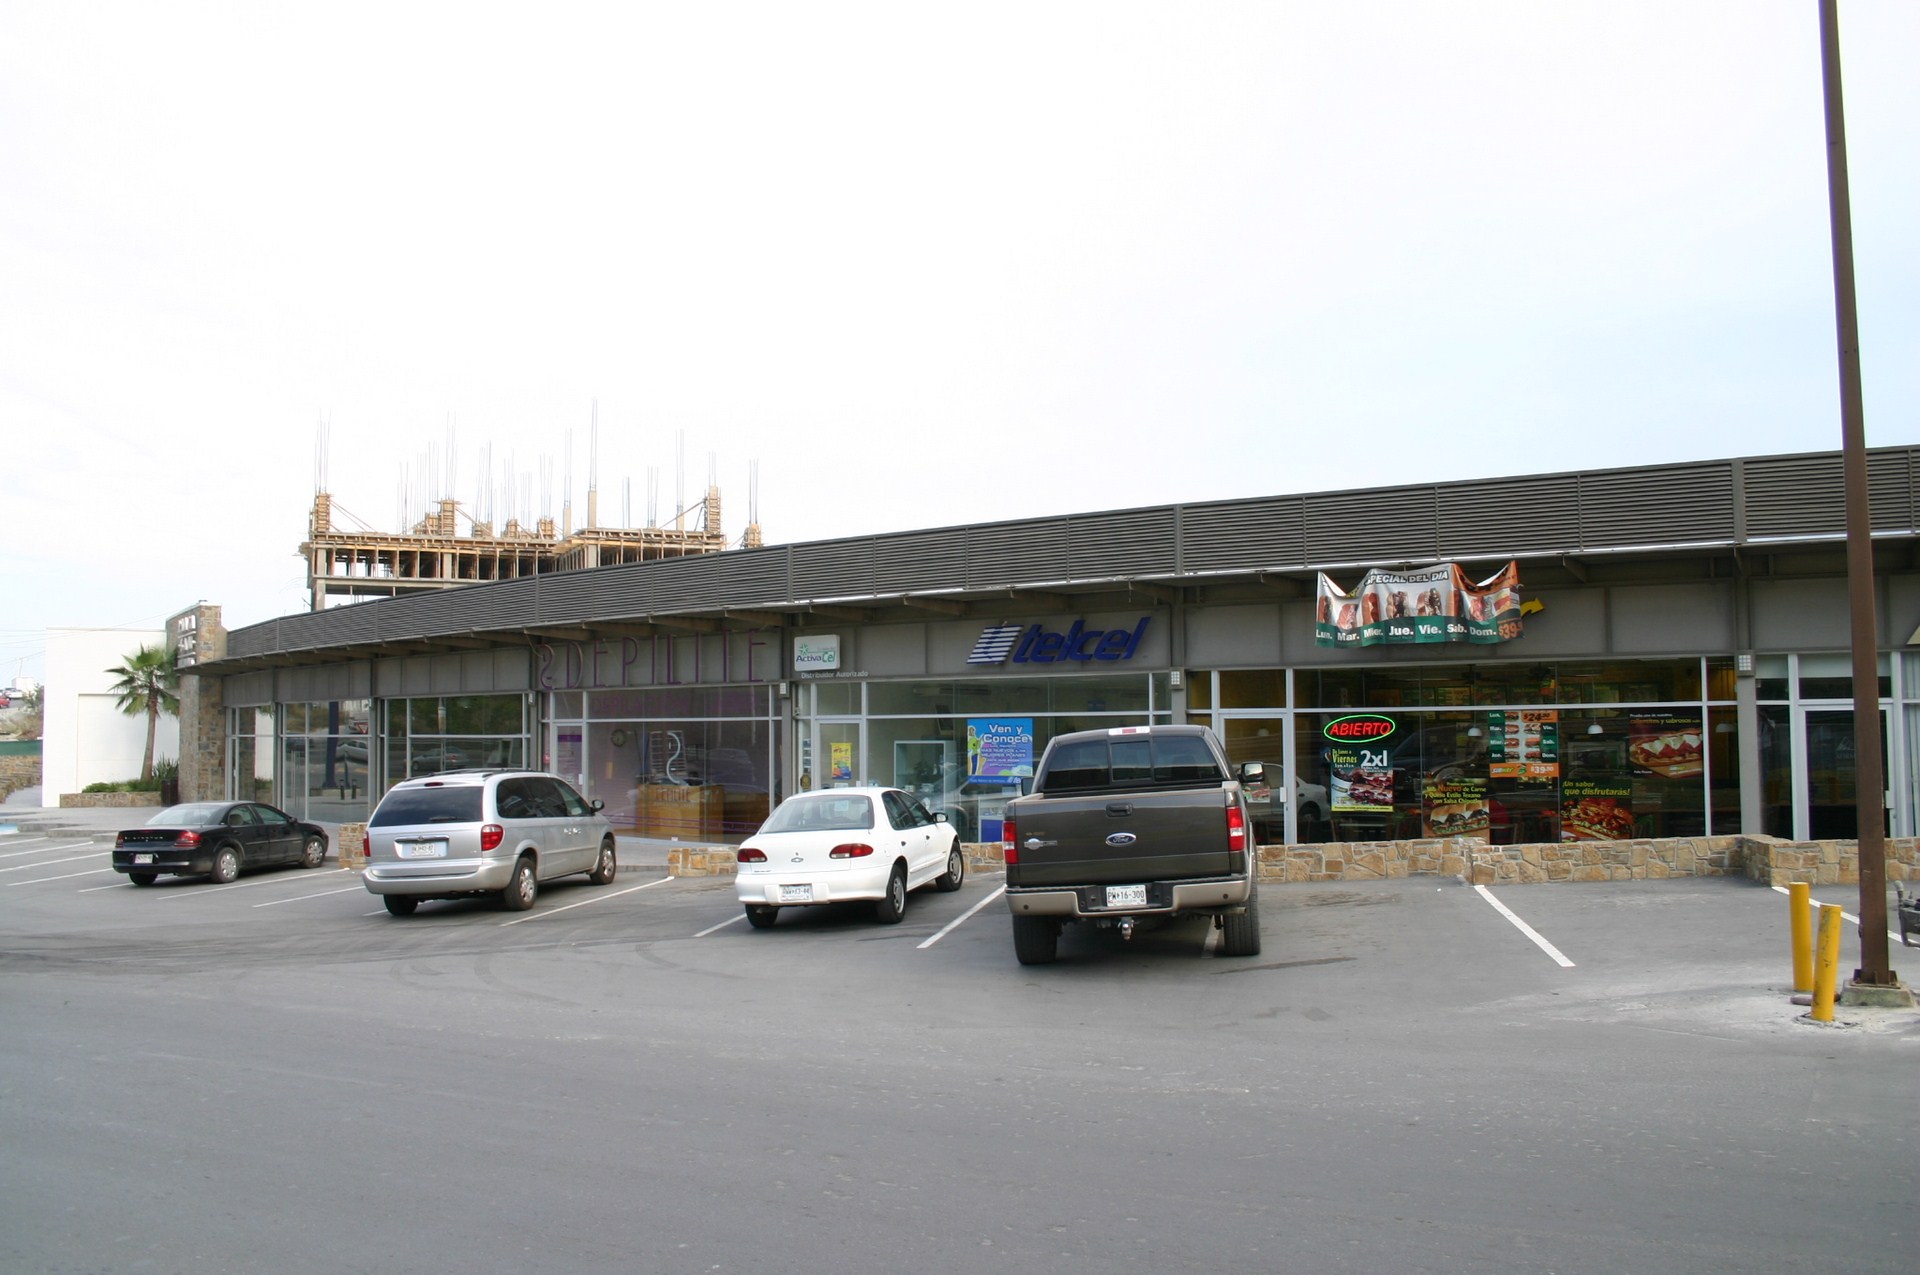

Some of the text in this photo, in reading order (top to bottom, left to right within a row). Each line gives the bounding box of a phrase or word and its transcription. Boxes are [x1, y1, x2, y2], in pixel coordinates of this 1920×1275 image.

[1408, 575, 1429, 583] DEL
[1337, 632, 1360, 642] Mar.
[1388, 625, 1414, 636] Jue.
[1418, 624, 1442, 635] Vie.
[1469, 626, 1497, 636] Dom.
[1013, 616, 1152, 664] telcel
[836, 670, 869, 678] Autorizado
[989, 724, 1023, 734] Ven y
[1328, 721, 1392, 736] ABIERTO
[983, 733, 1029, 743] Conoce
[1332, 753, 1358, 763] Viernes
[1564, 787, 1580, 796] que
[1112, 835, 1130, 843] Ford
